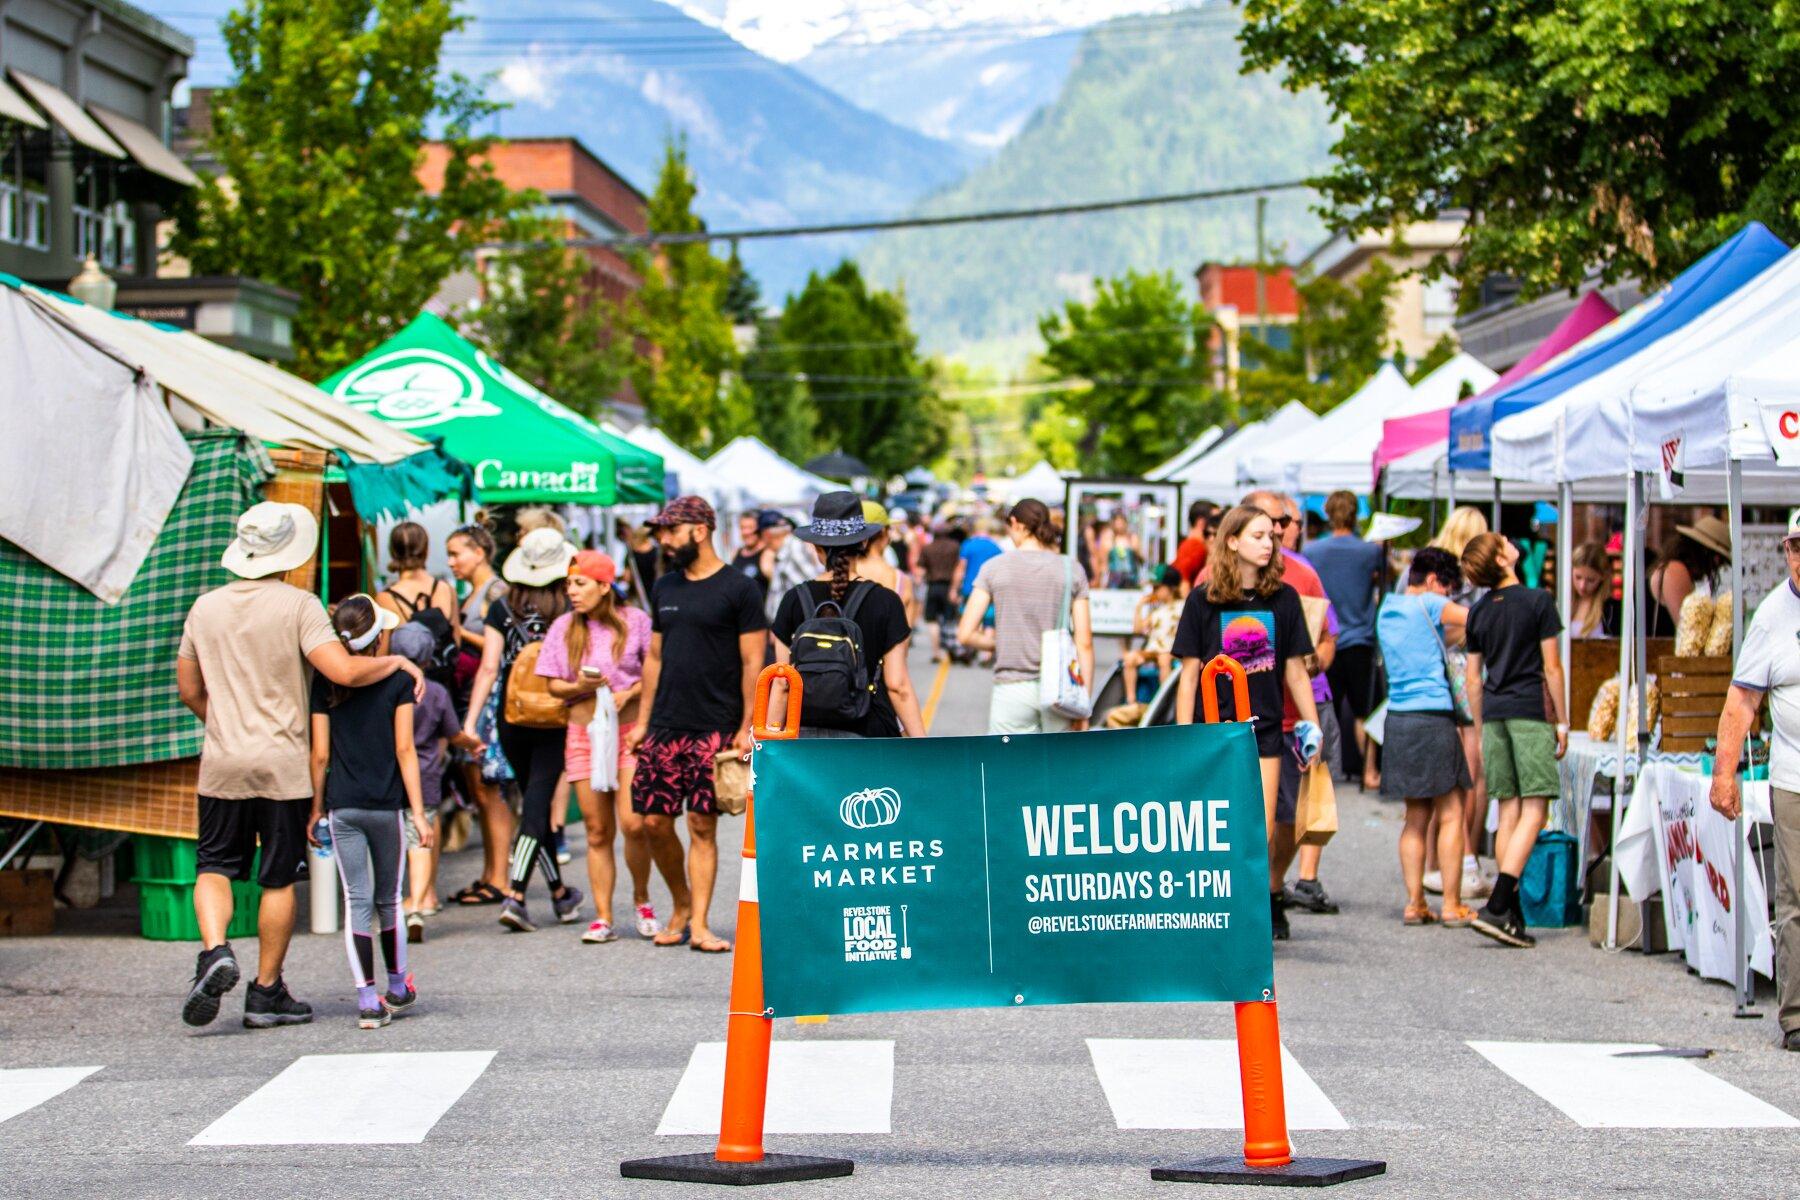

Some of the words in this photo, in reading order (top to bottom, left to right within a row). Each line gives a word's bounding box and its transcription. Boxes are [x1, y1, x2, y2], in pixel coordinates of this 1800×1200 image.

[474, 458, 600, 492] Canada
[1022, 800, 1231, 857] WELCOME
[802, 840, 944, 863] FARMERS
[814, 866, 936, 888] MARKET
[1025, 871, 1153, 903] SATURDAYS
[1159, 870, 1231, 899] 8-1PM
[843, 905, 891, 917] REVELSTOKE
[843, 915, 897, 941] LOCAL
[1028, 912, 1231, 934] @REVELSTOKEFARMERSMARKET
[845, 939, 898, 952] FOOD
[845, 950, 898, 962] INITIATIVE
